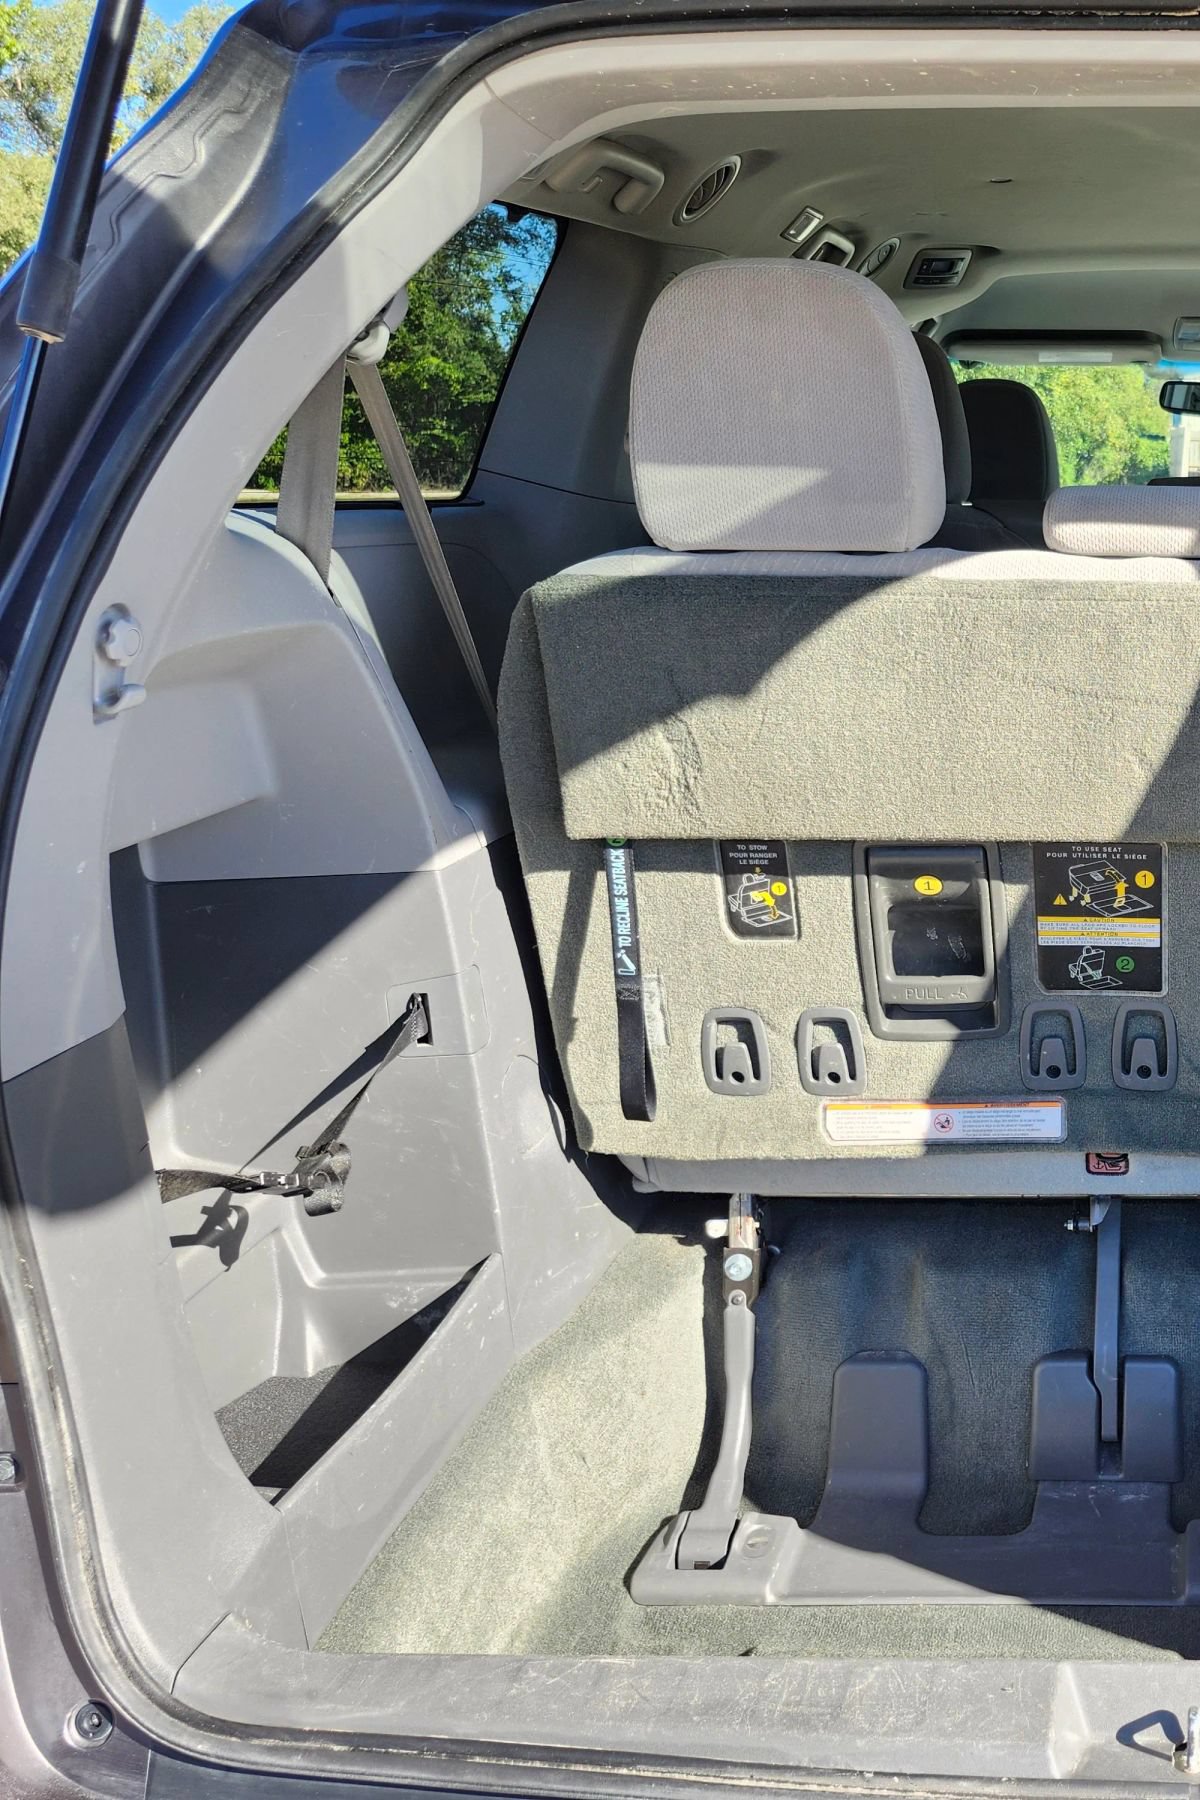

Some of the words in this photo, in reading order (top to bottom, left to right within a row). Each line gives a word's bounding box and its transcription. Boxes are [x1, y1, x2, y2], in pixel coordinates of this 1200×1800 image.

[610, 848, 629, 896] SEATBACK
[615, 897, 631, 935] RECLINE
[618, 936, 632, 948] TO
[1120, 958, 1130, 970] 2
[904, 987, 944, 1000] PULL
